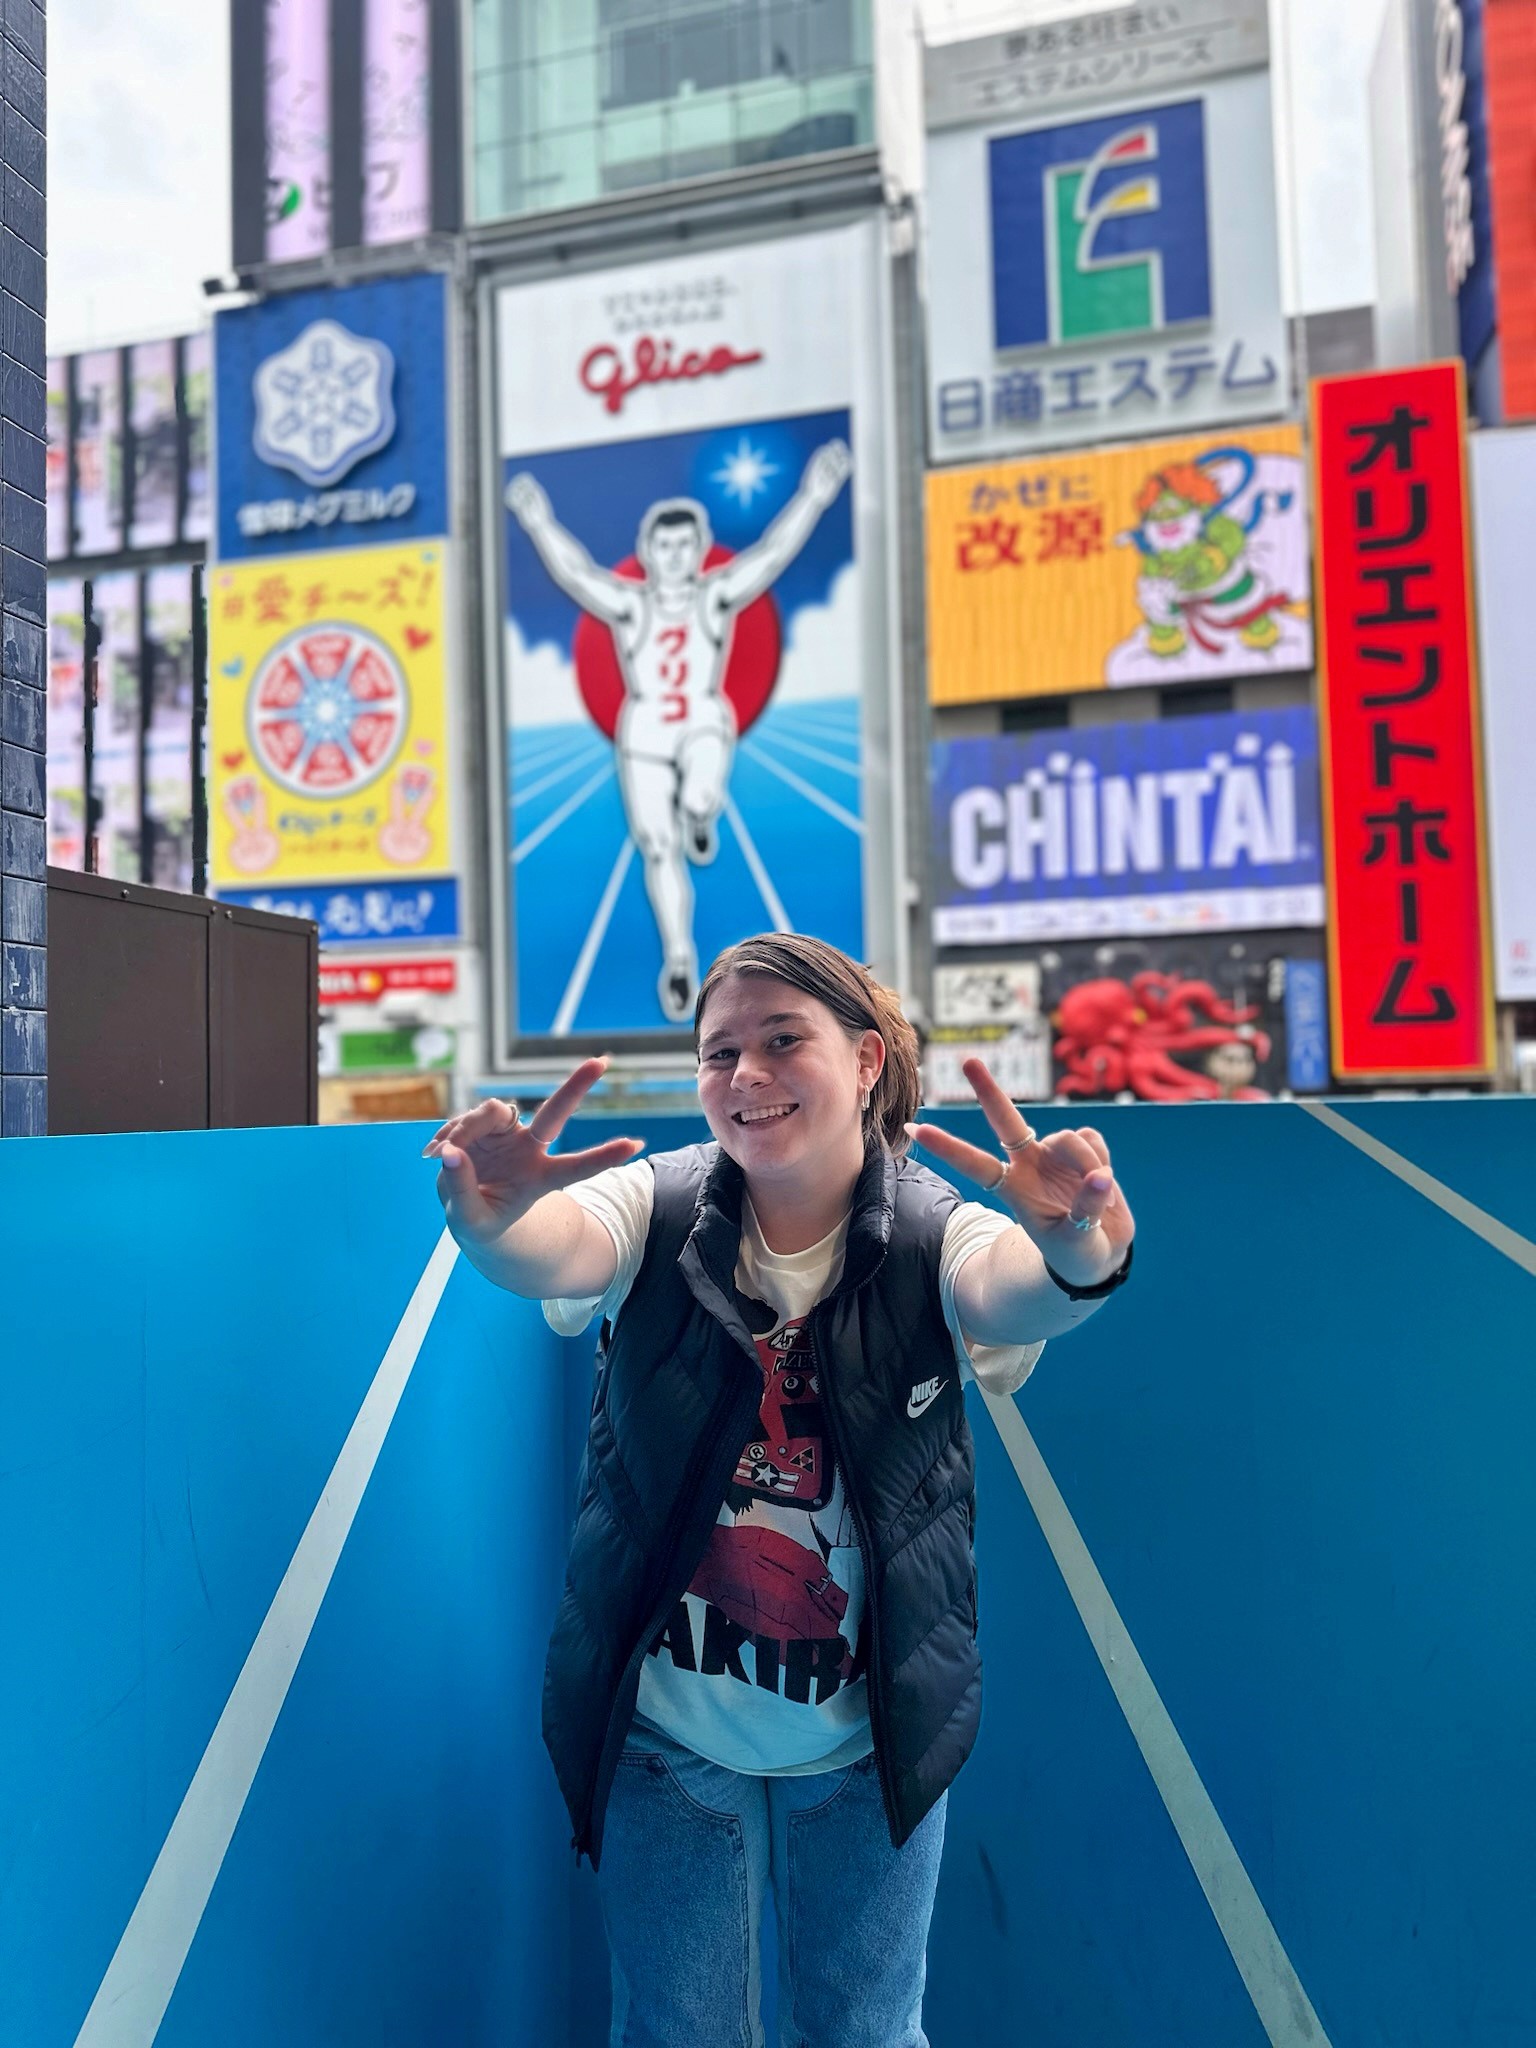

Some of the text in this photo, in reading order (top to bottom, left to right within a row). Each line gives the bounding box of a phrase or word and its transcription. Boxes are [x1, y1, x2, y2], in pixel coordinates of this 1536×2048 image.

[938, 341, 1278, 433] 日商エステム
[1348, 407, 1457, 1026] オリエントホーム
[911, 1376, 939, 1404] NIKE
